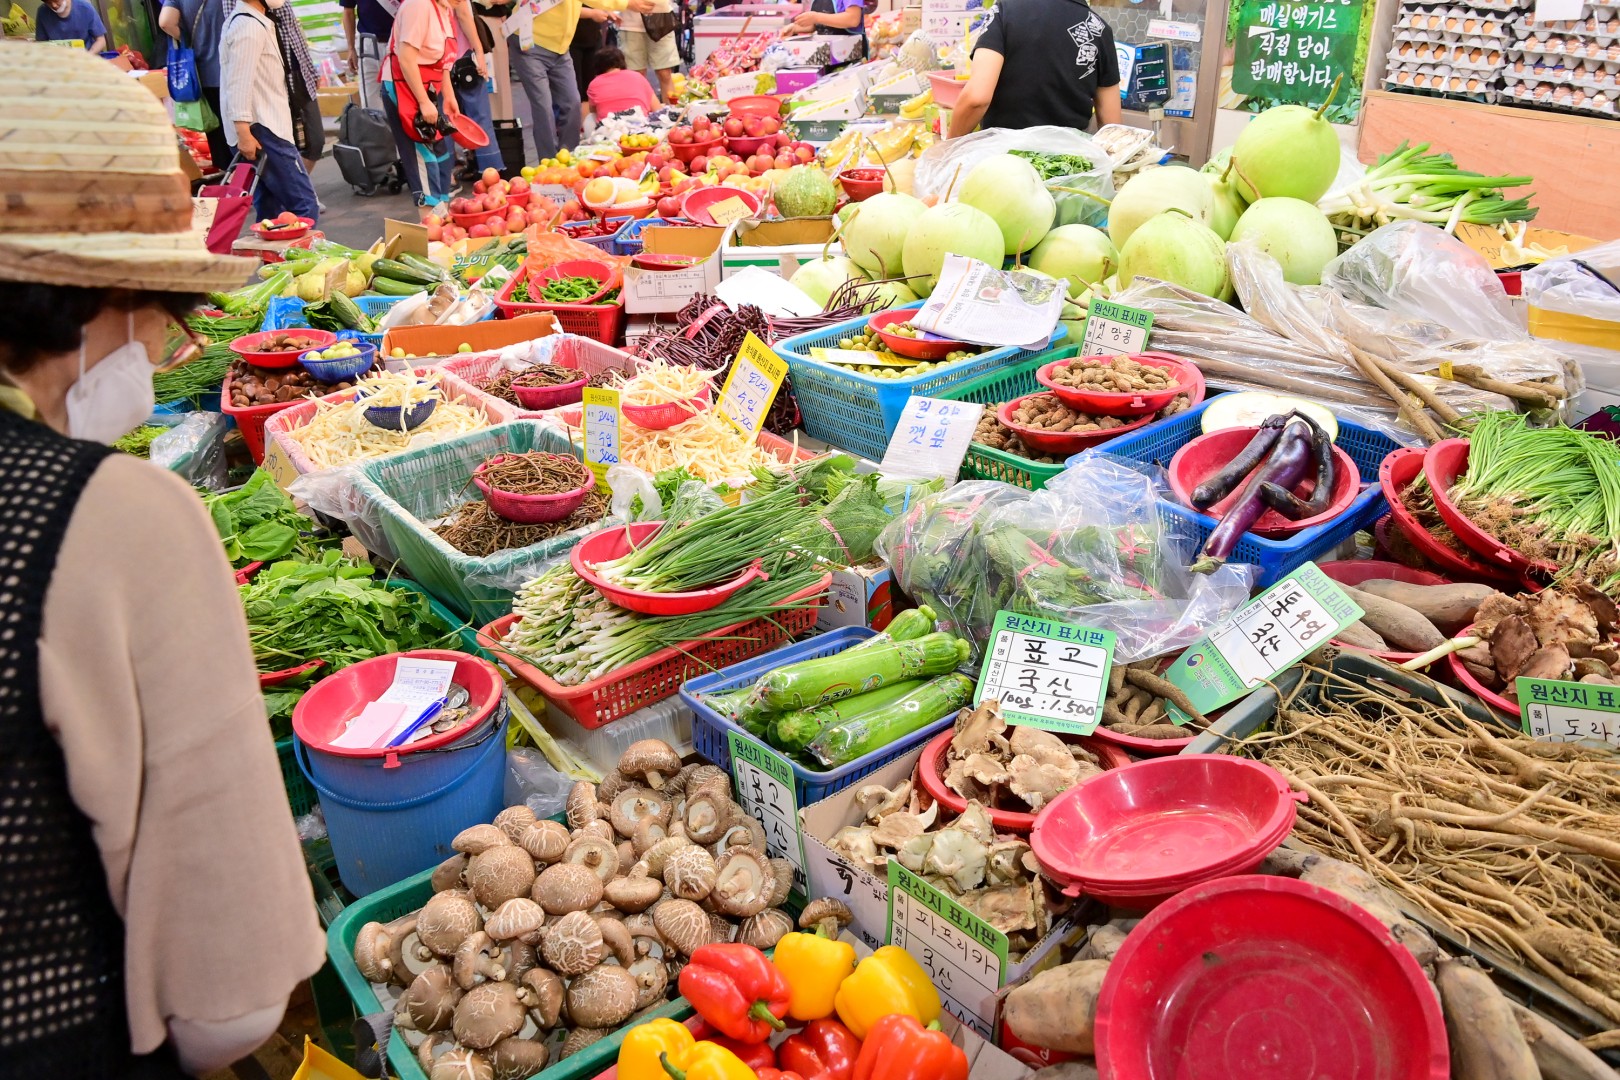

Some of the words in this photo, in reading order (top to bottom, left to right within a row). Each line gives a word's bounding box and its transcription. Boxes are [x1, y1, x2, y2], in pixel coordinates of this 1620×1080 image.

[1260, 3, 1337, 29] 매실액기스
[1259, 32, 1291, 56] 직접
[1297, 35, 1330, 60] 담아
[1094, 302, 1120, 319] 원산지
[1121, 309, 1148, 326] 표시판
[1298, 568, 1330, 597] 원산지
[1322, 591, 1356, 621] 표시판
[1005, 615, 1052, 635] 원산지
[1057, 625, 1105, 646] 표시판
[1251, 622, 1281, 657] 국산
[1018, 668, 1073, 699] 국산
[1530, 684, 1588, 706] 원산지
[1564, 719, 1620, 750] 도라
[735, 738, 762, 767] 원산지
[763, 754, 789, 785] 표시판
[898, 870, 942, 912] 원산지
[949, 905, 997, 950] 표시판
[915, 908, 997, 975] 파프리카
